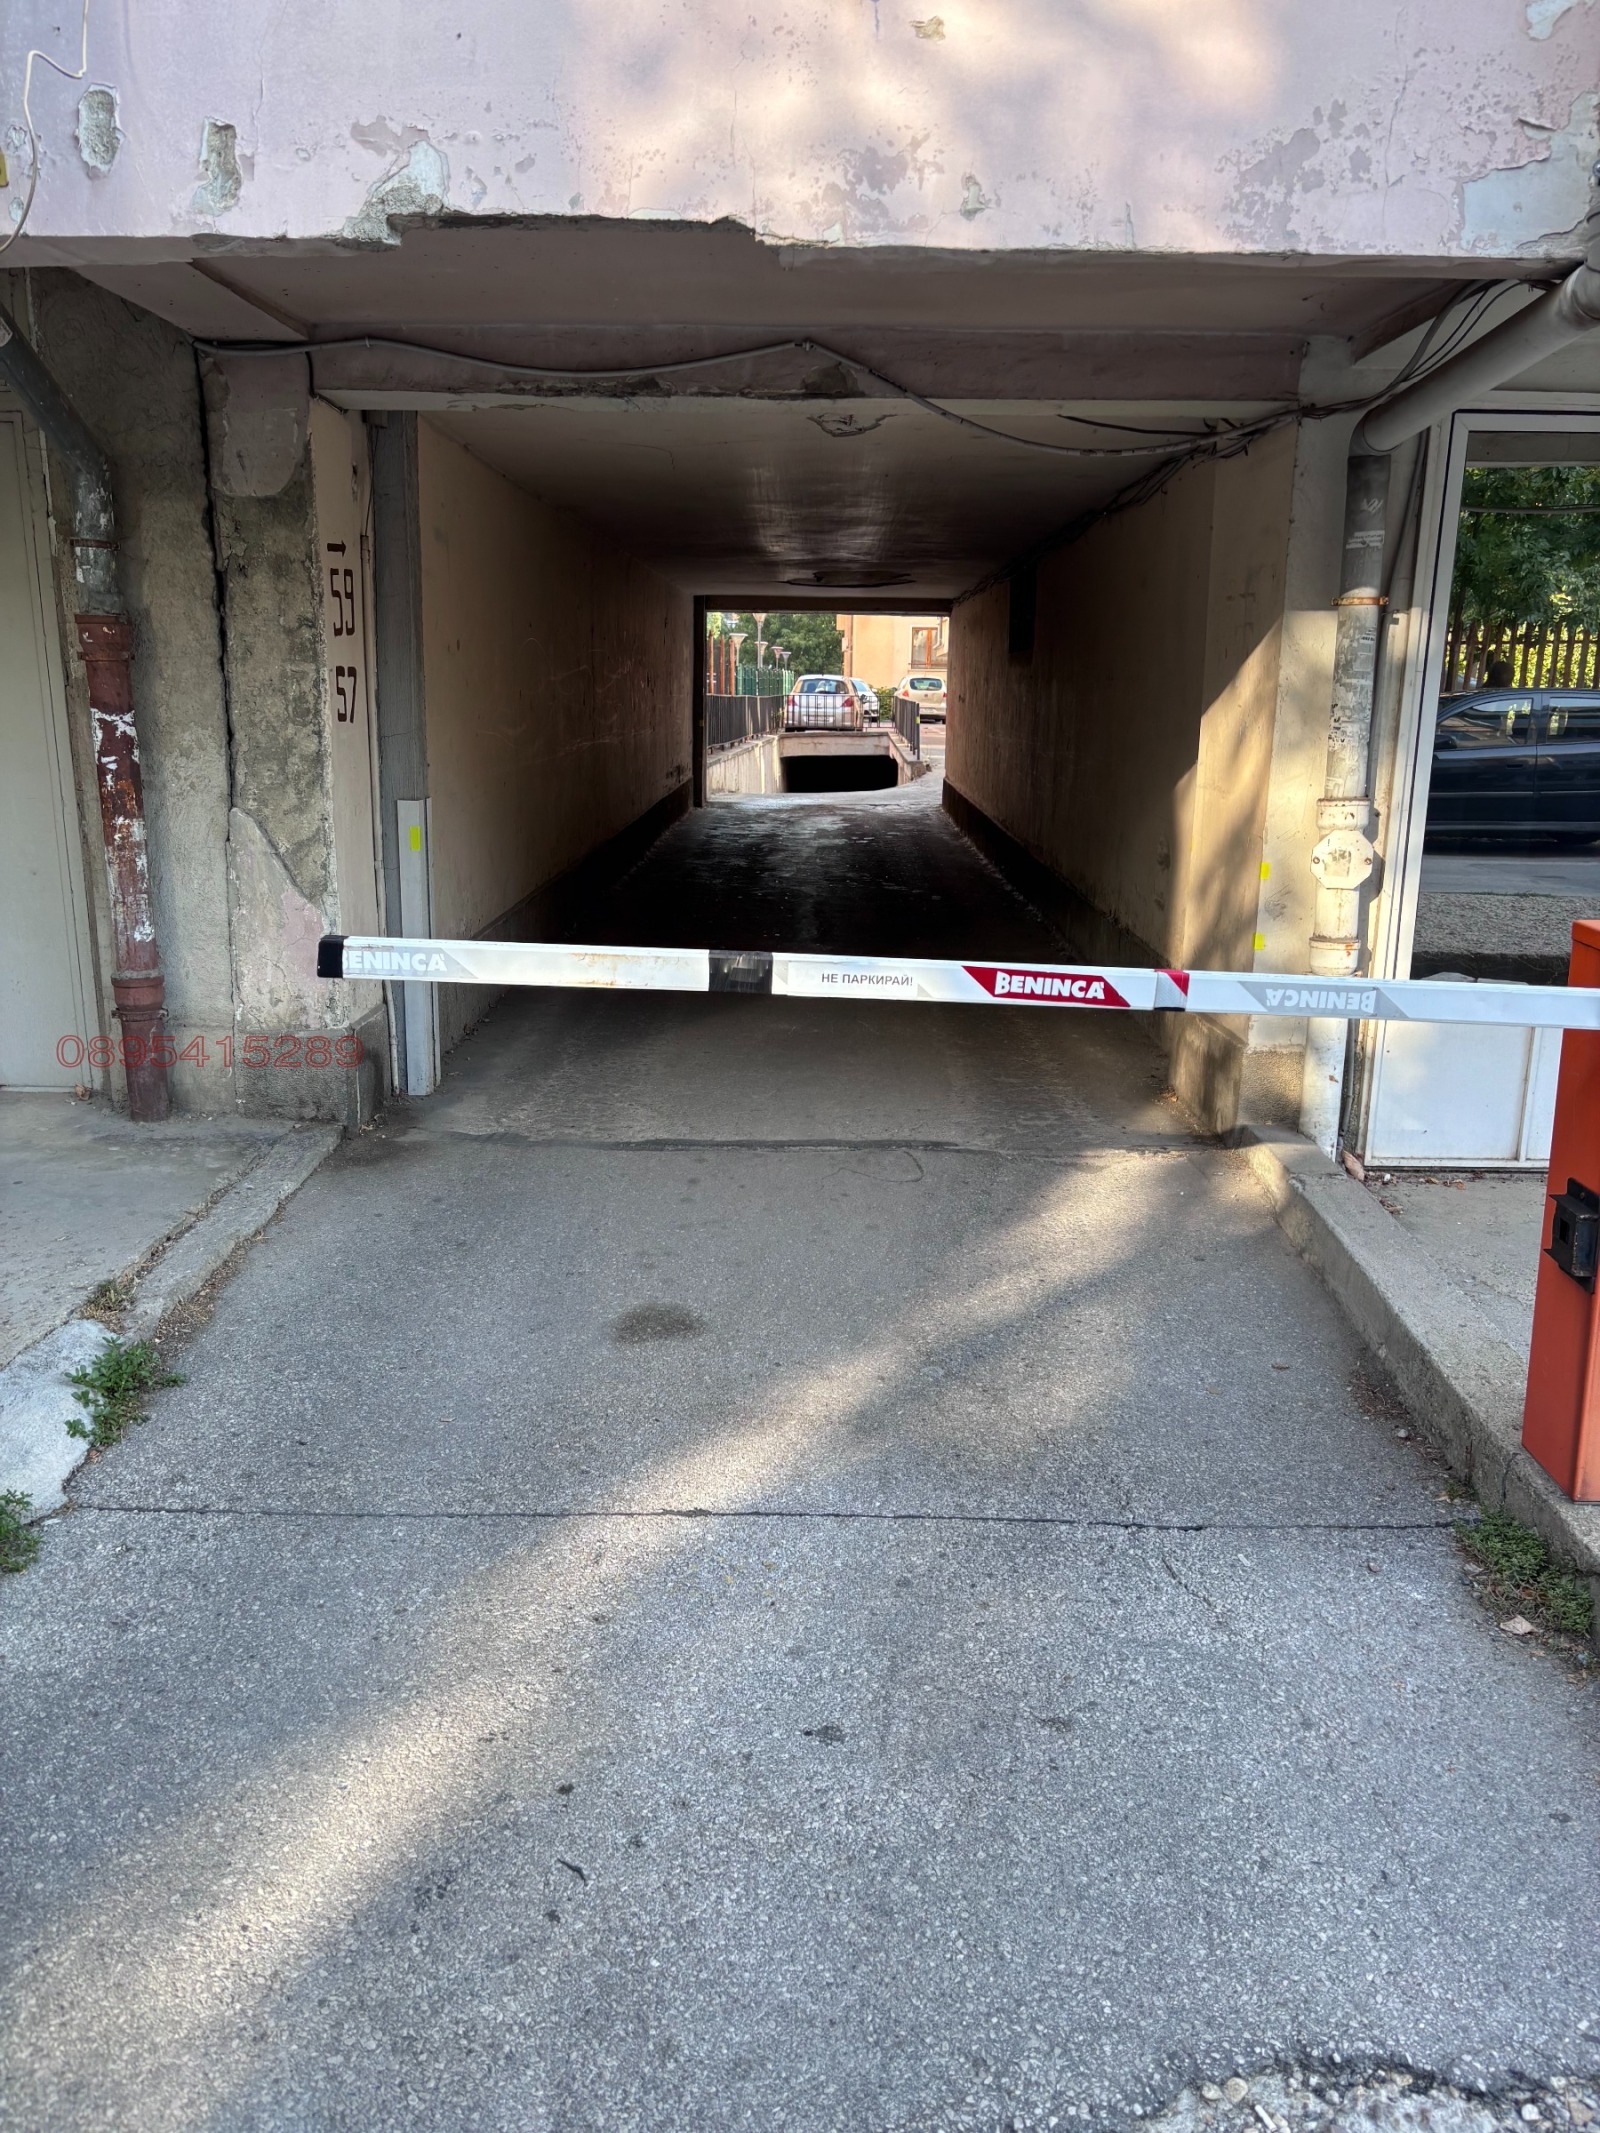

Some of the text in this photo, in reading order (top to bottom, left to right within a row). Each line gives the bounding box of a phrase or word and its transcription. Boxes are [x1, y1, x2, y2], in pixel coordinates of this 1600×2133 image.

[330, 568, 355, 637] 59
[335, 665, 357, 724] 57
[821, 973, 913, 987] НЕ ПАРКИРАЙ!
